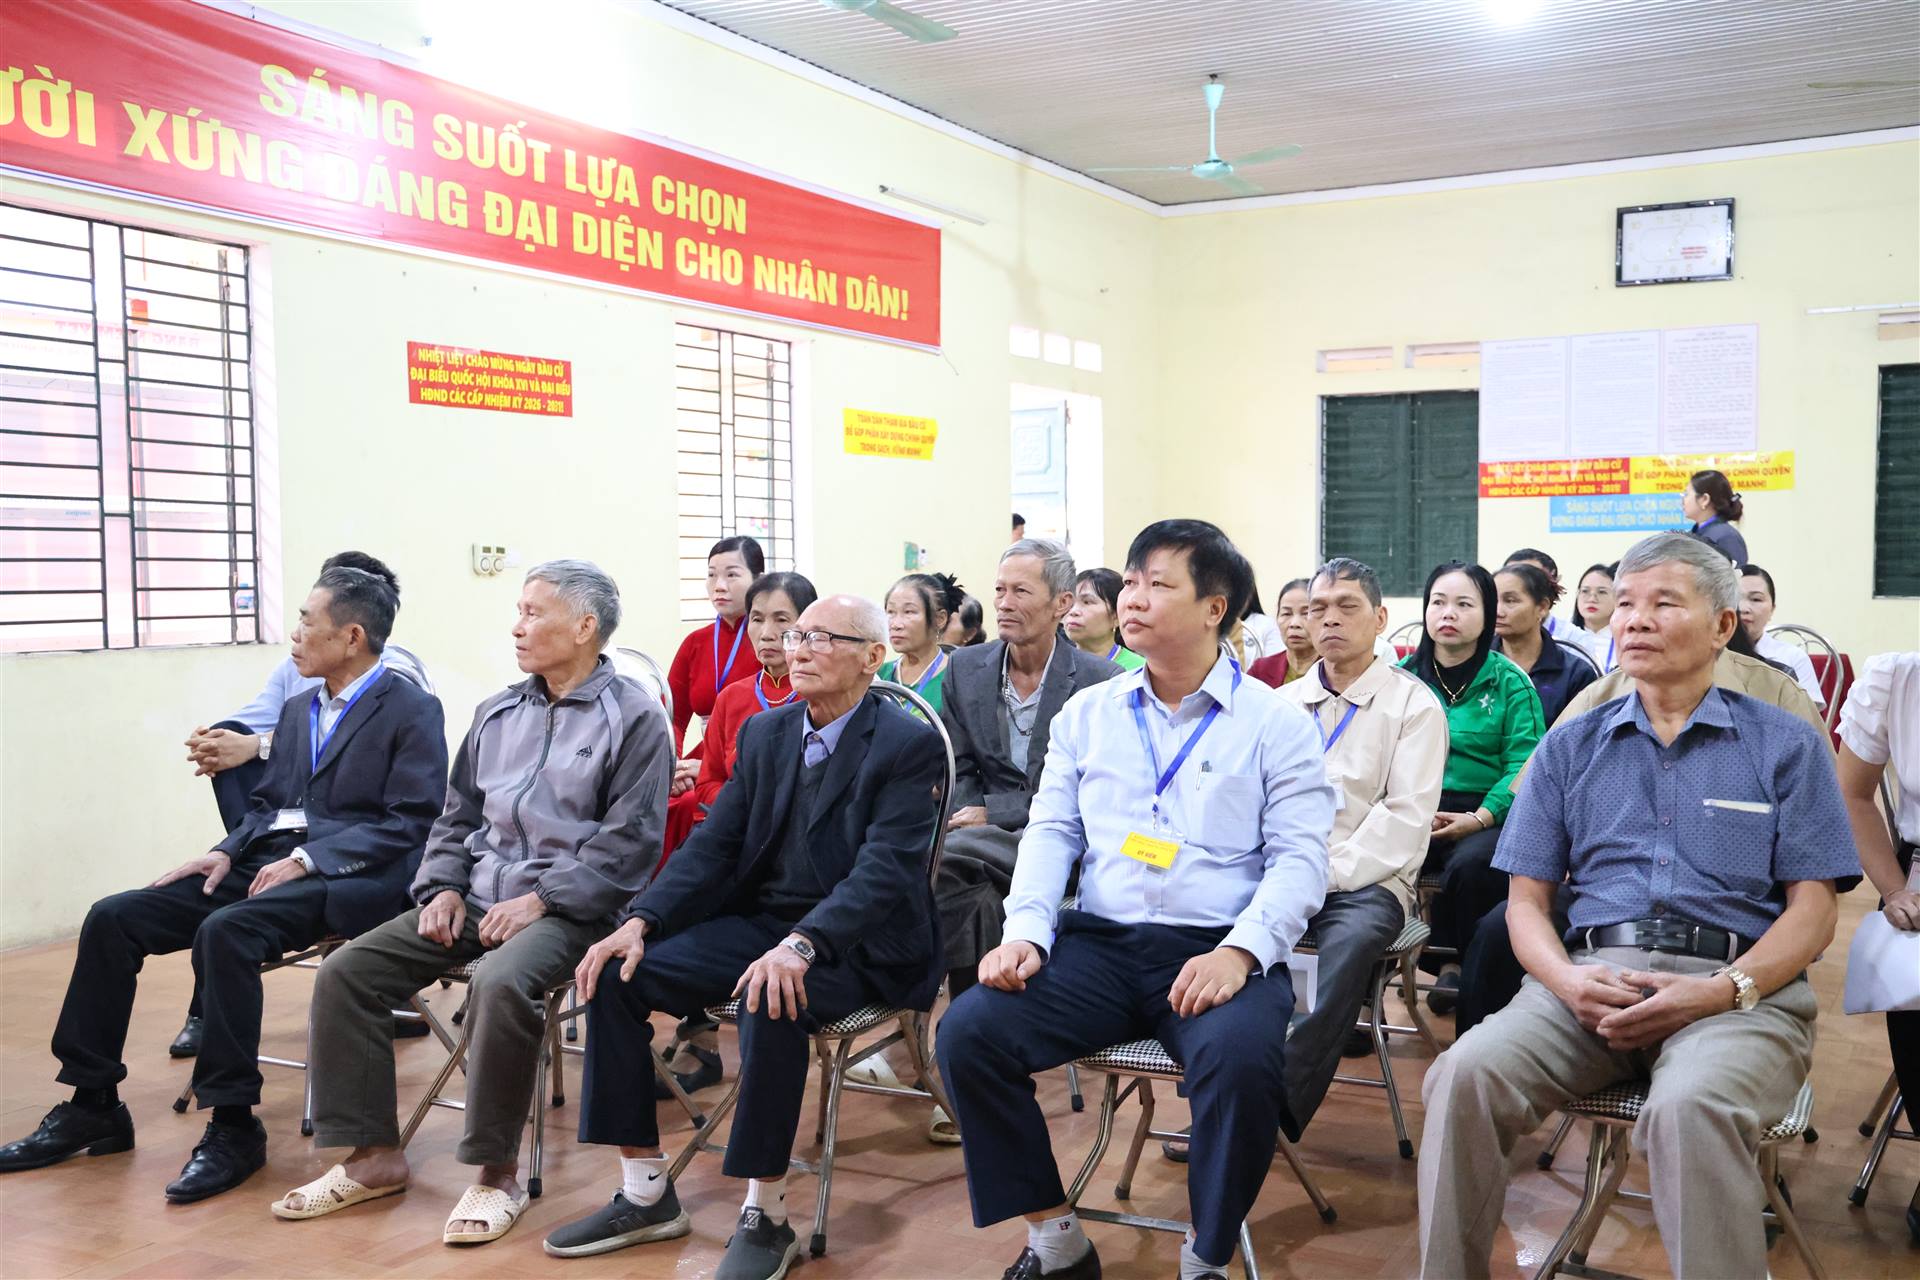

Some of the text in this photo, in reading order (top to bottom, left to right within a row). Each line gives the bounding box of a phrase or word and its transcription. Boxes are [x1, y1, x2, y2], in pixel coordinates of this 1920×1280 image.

[259, 63, 747, 235] SÁNG SUỐT LỰA CHỌN
[122, 101, 304, 193] XỨNG
[483, 190, 558, 252] ĐẠI
[572, 214, 664, 272] DIỆN
[675, 237, 743, 287] CHO
[753, 254, 838, 307] NHÂN
[846, 275, 909, 321] DÂN!
[418, 347, 445, 366] NHIỆT
[447, 350, 463, 368] LIỆT
[466, 353, 490, 369] CHÀO
[410, 367, 427, 384] ĐẠI
[428, 365, 449, 383] BIỂU
[451, 367, 475, 386] QUỐC
[476, 372, 491, 389] HỘI
[528, 378, 540, 393] VÀ
[541, 381, 556, 397] ĐẠI
[420, 387, 448, 402] HĐND
[449, 386, 466, 403] CÁC
[467, 387, 484, 405] CẤP
[484, 390, 511, 411] NHIỆM
